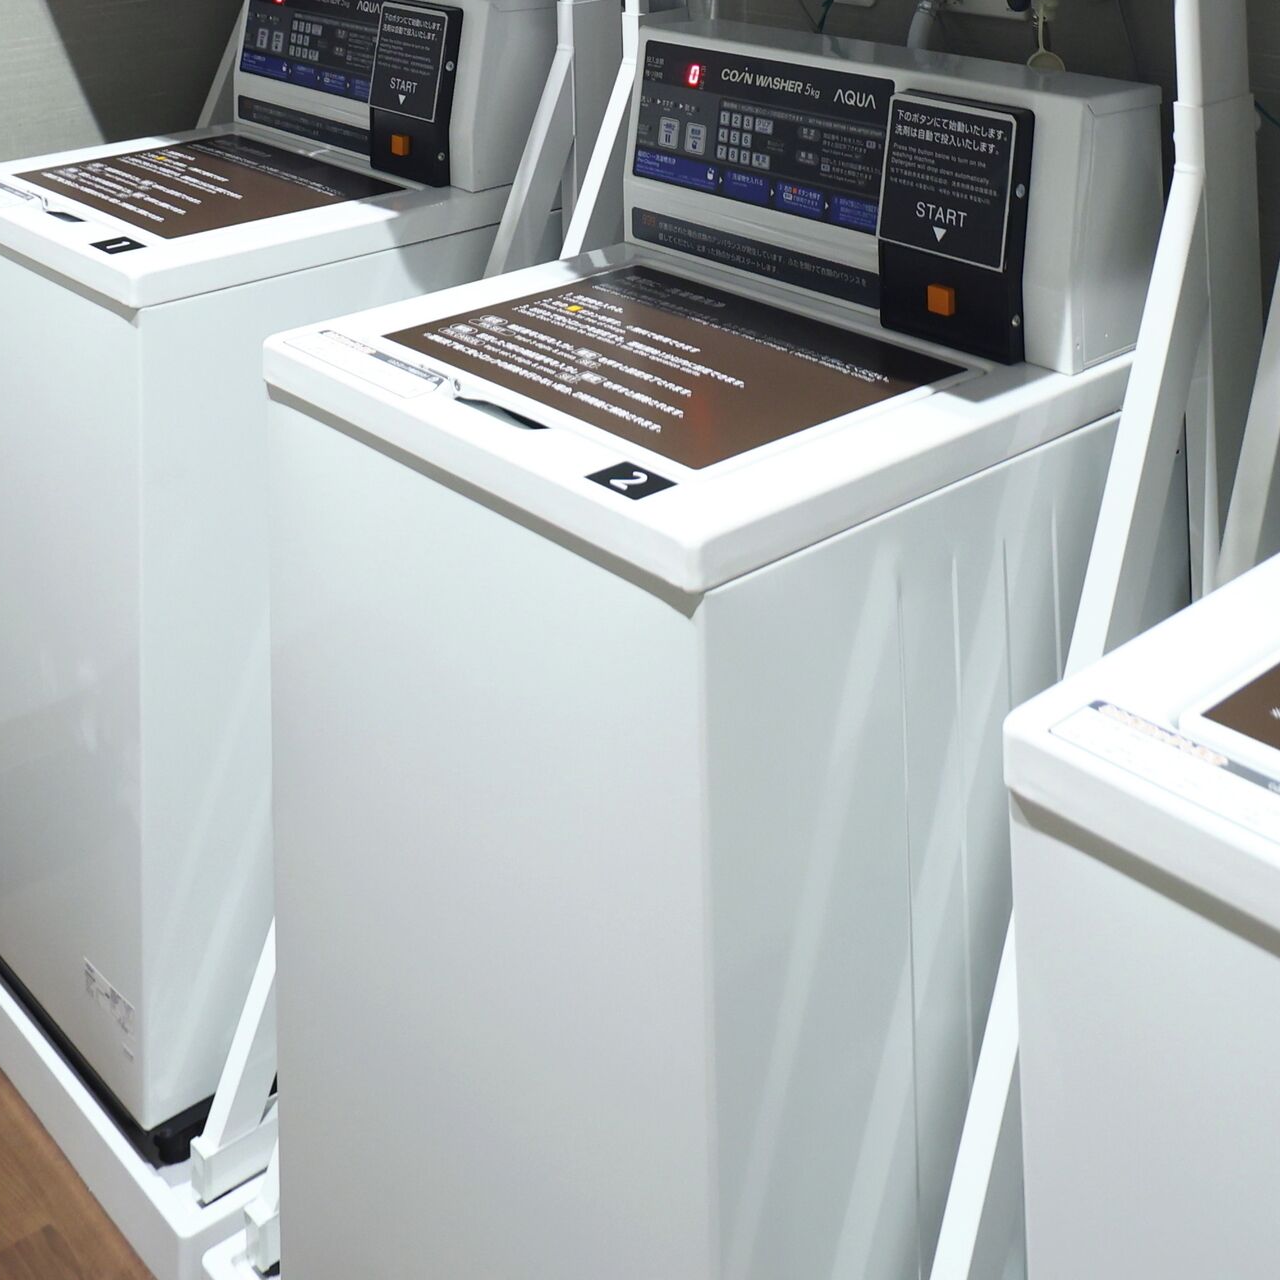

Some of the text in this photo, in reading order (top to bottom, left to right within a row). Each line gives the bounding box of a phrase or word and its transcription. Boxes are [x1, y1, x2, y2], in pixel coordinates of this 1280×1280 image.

[356, 0, 380, 14] AQUA
[389, 76, 418, 95] START
[688, 64, 700, 84] 0
[756, 73, 804, 96] WASHER
[804, 82, 820, 100] 5kg
[833, 87, 877, 111] AQUA
[896, 109, 1009, 142] 下のボタンにて始動いたします。
[894, 123, 1000, 156] 洗剤は自動で投入いたします。
[917, 147, 934, 157] button
[915, 201, 967, 228] START
[609, 470, 649, 492] 2
